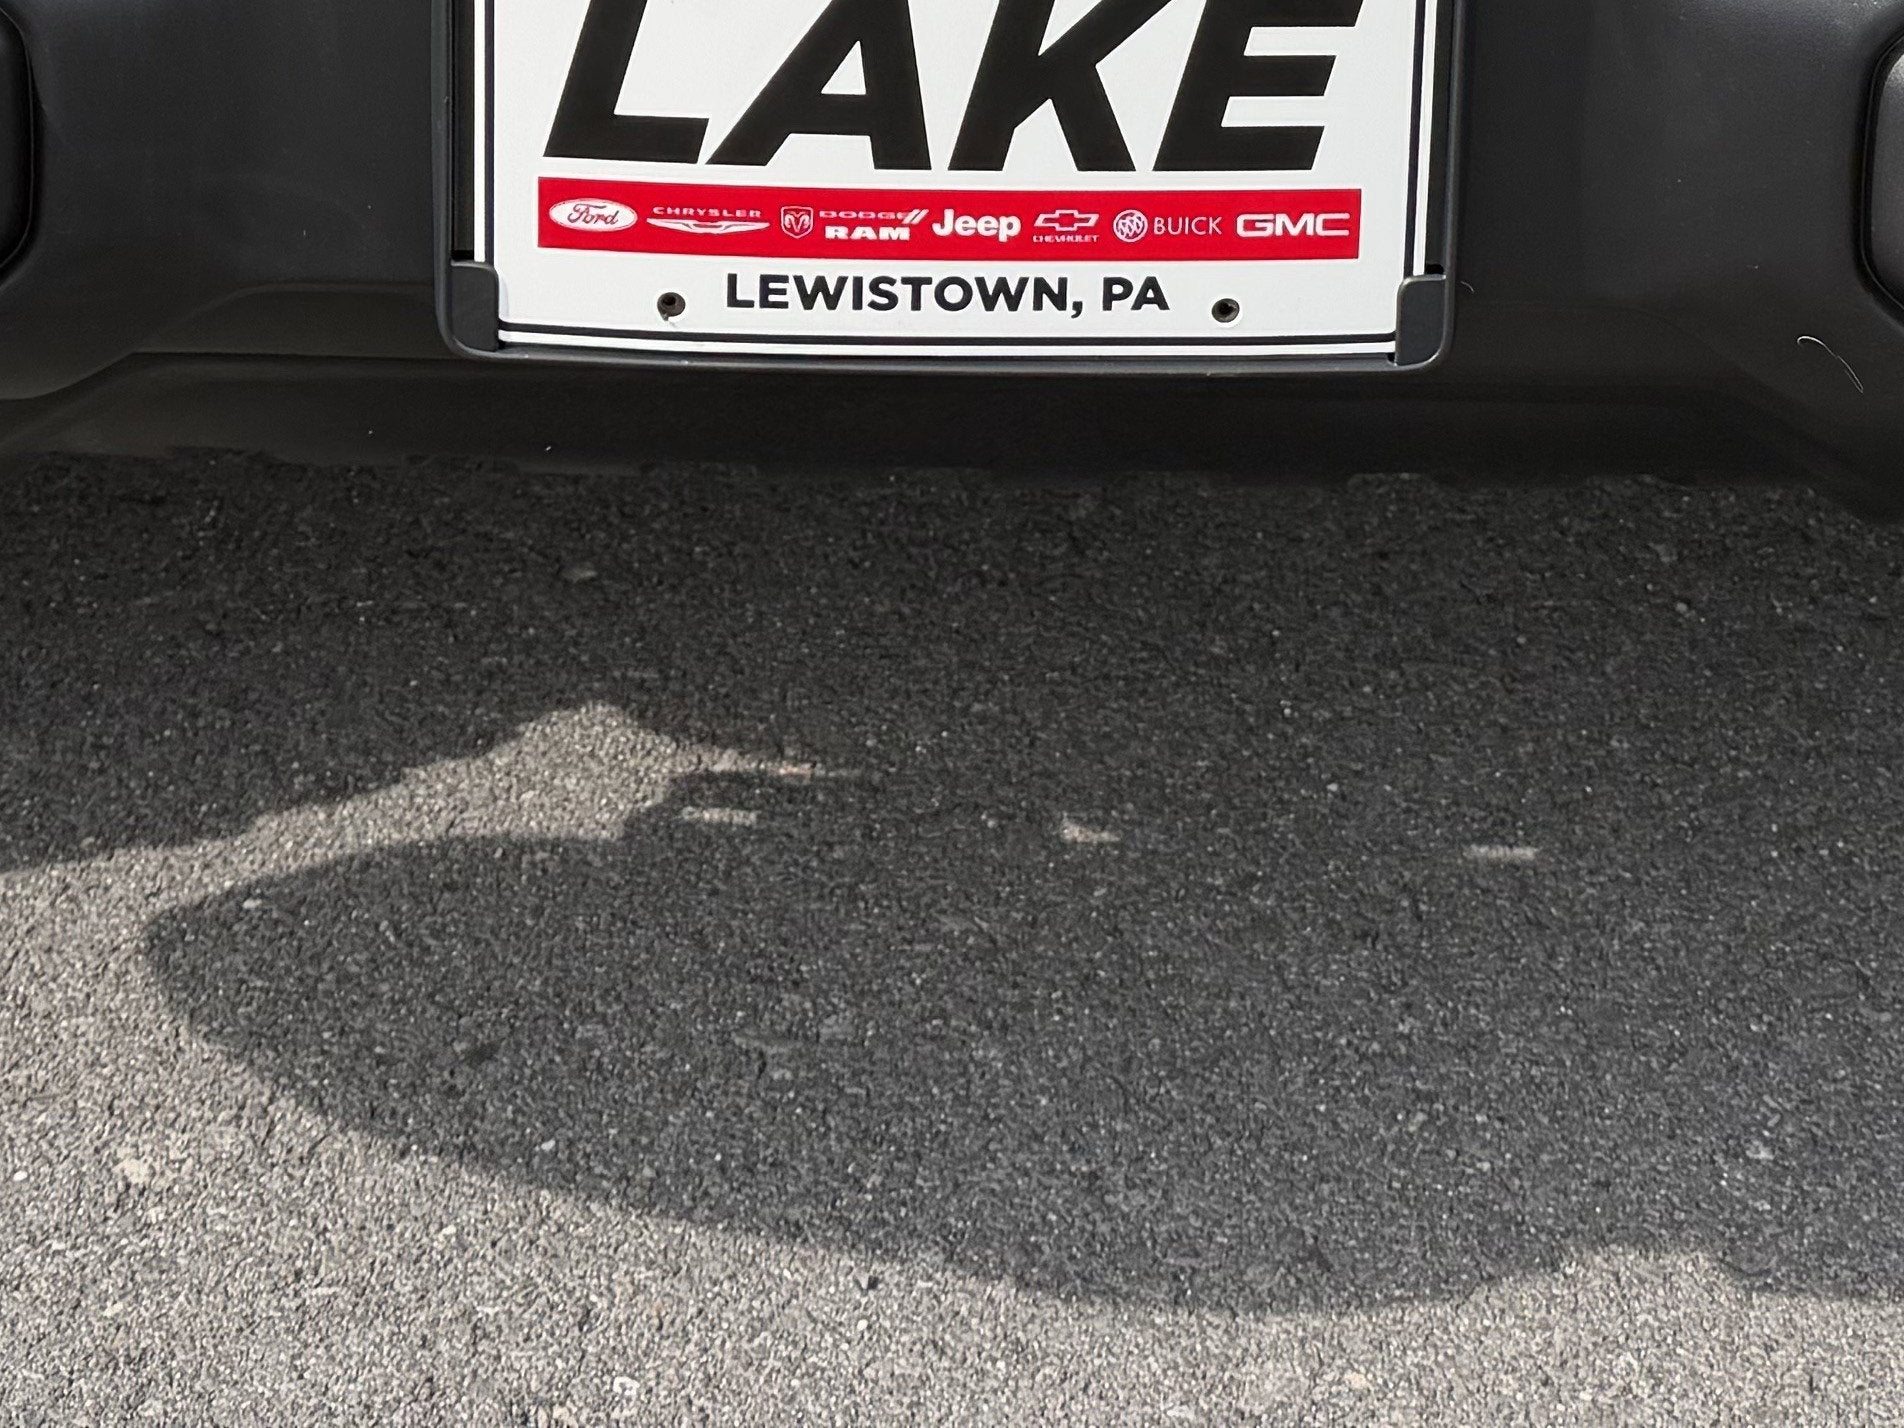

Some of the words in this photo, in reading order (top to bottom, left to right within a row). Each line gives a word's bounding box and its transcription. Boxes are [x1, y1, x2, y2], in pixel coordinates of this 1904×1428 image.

[567, 203, 619, 225] Ford
[652, 206, 762, 218] CHRYSLER
[825, 225, 910, 241] RAM
[932, 208, 1021, 242] Jeep
[1153, 216, 1222, 236] BUICK
[1236, 212, 1351, 237] GMC
[726, 273, 1084, 319] LEWISTOWN,
[1102, 276, 1171, 312] PA
